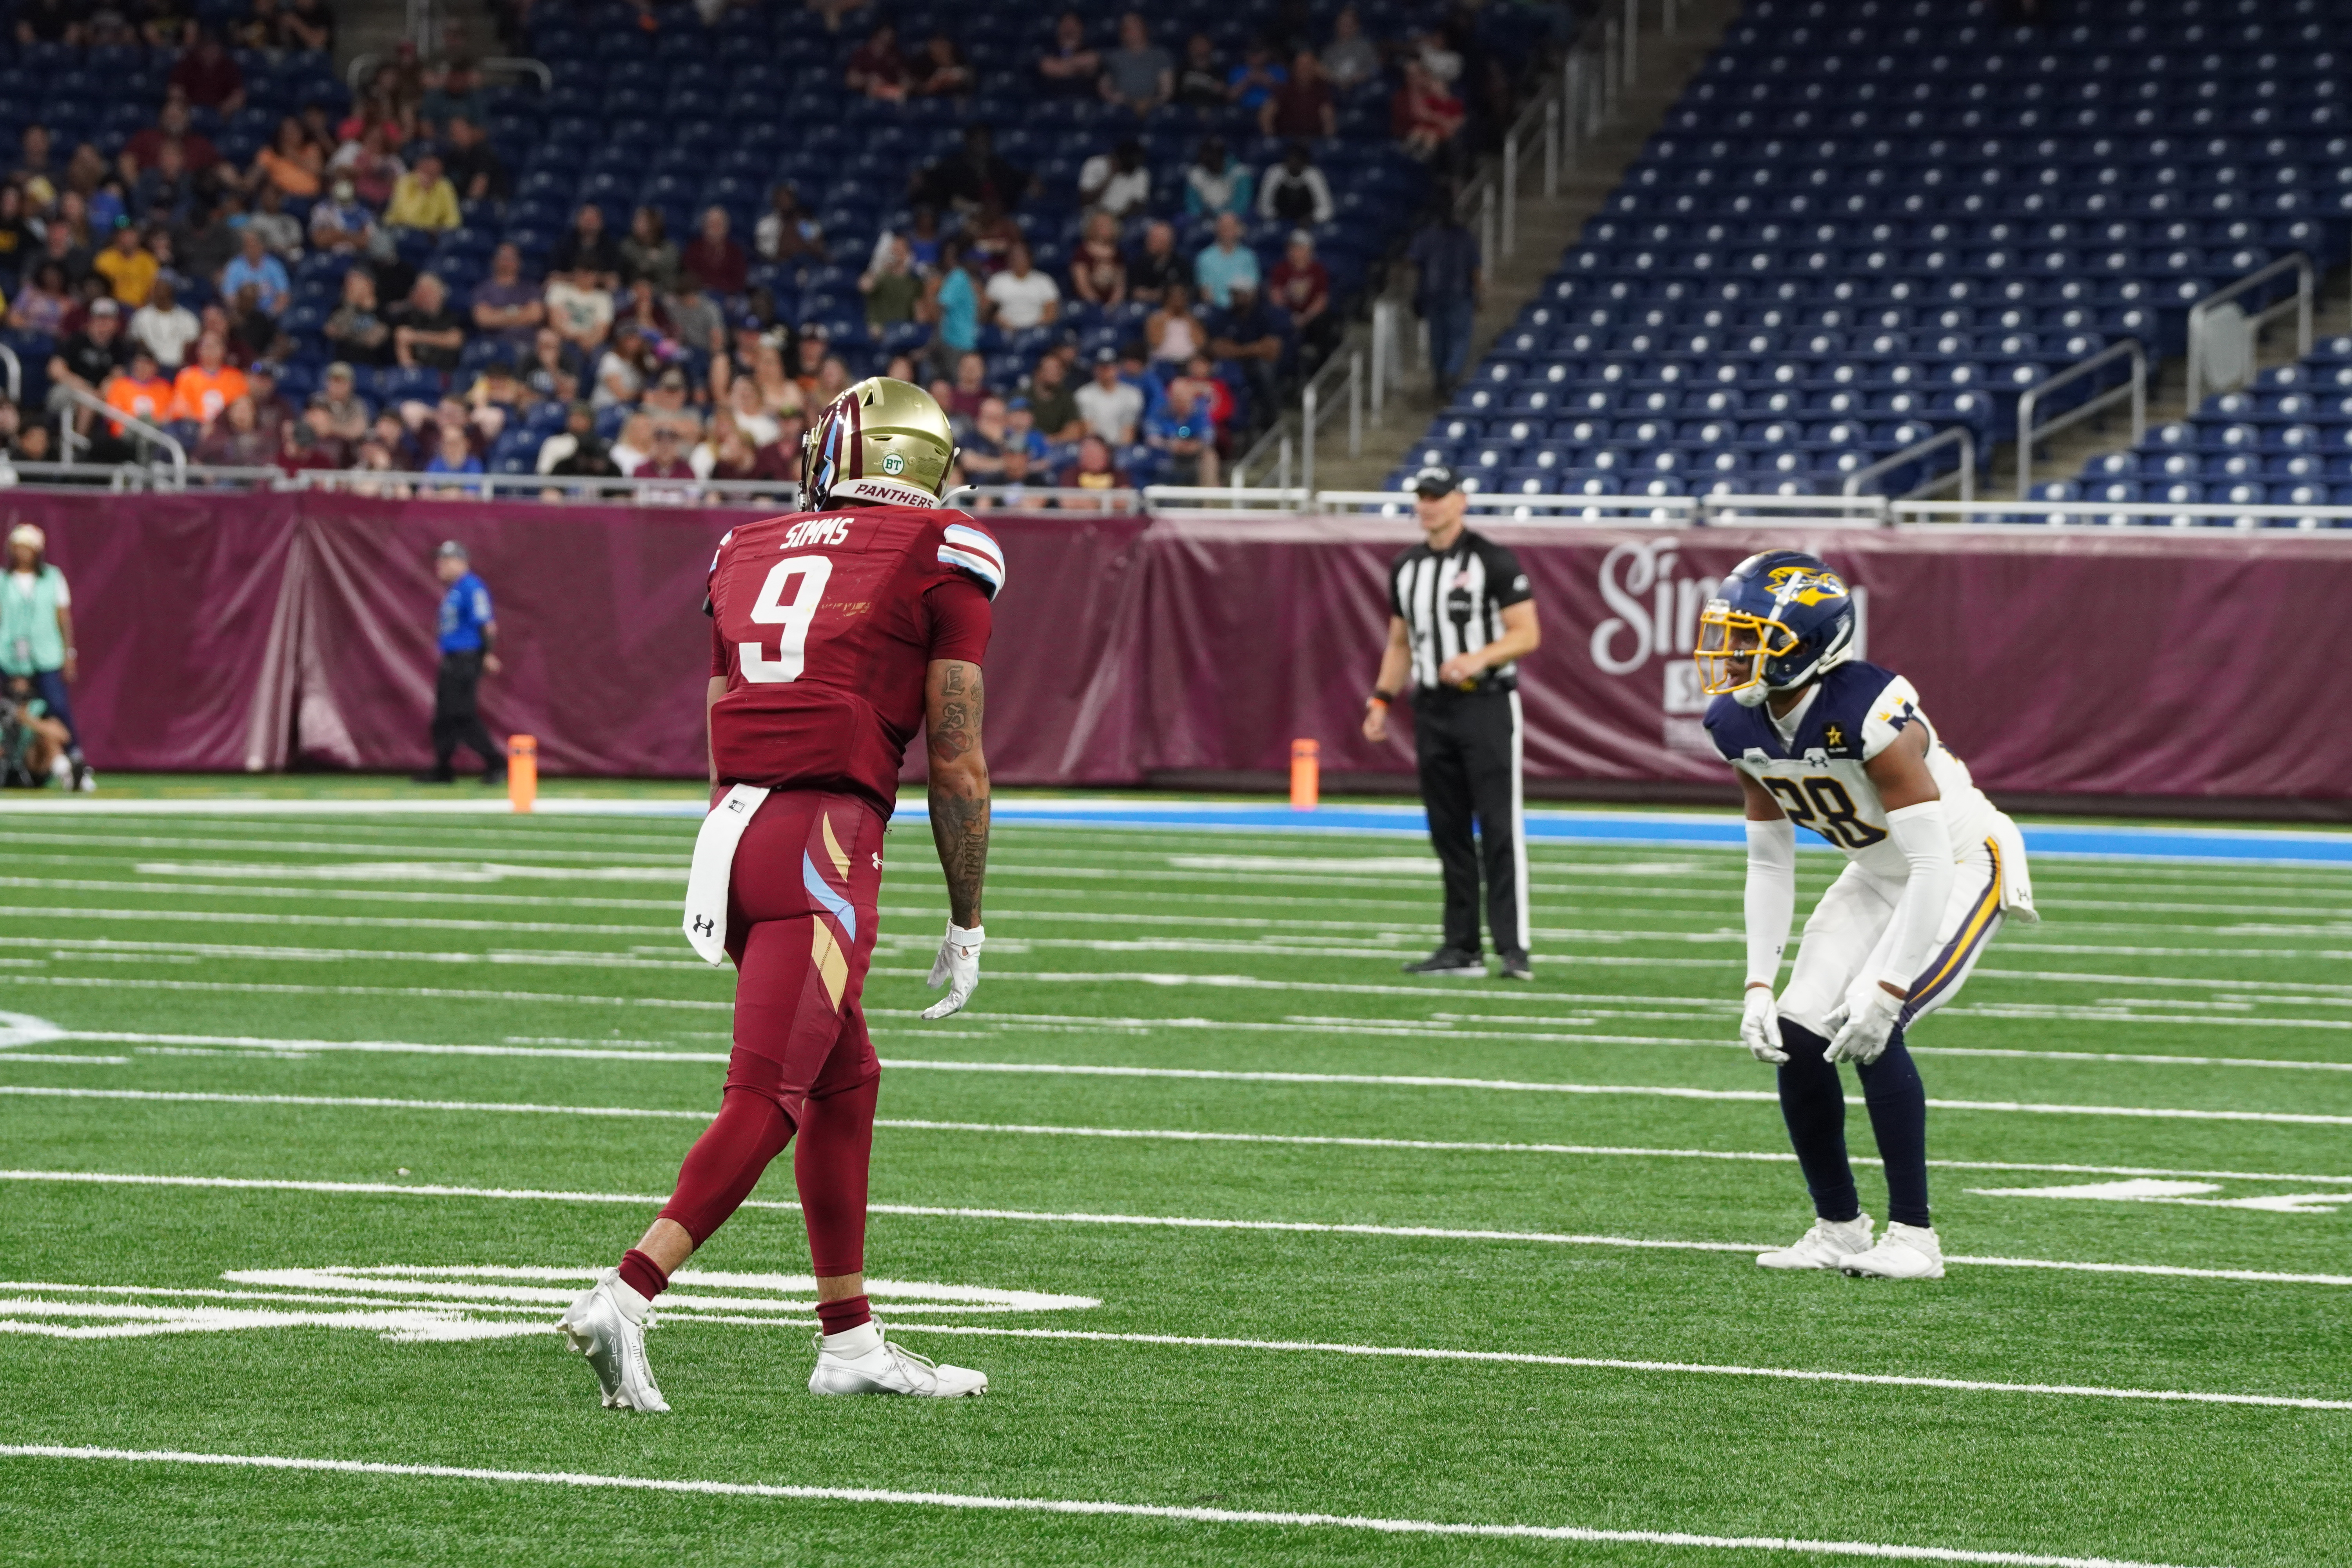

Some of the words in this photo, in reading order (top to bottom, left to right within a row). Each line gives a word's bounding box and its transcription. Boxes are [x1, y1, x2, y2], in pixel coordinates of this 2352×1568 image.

[885, 458, 902, 470] BT
[854, 484, 934, 509] PANTHERS
[779, 517, 855, 549] SIMMS
[739, 555, 833, 683] 9
[1761, 776, 1888, 850] 28
